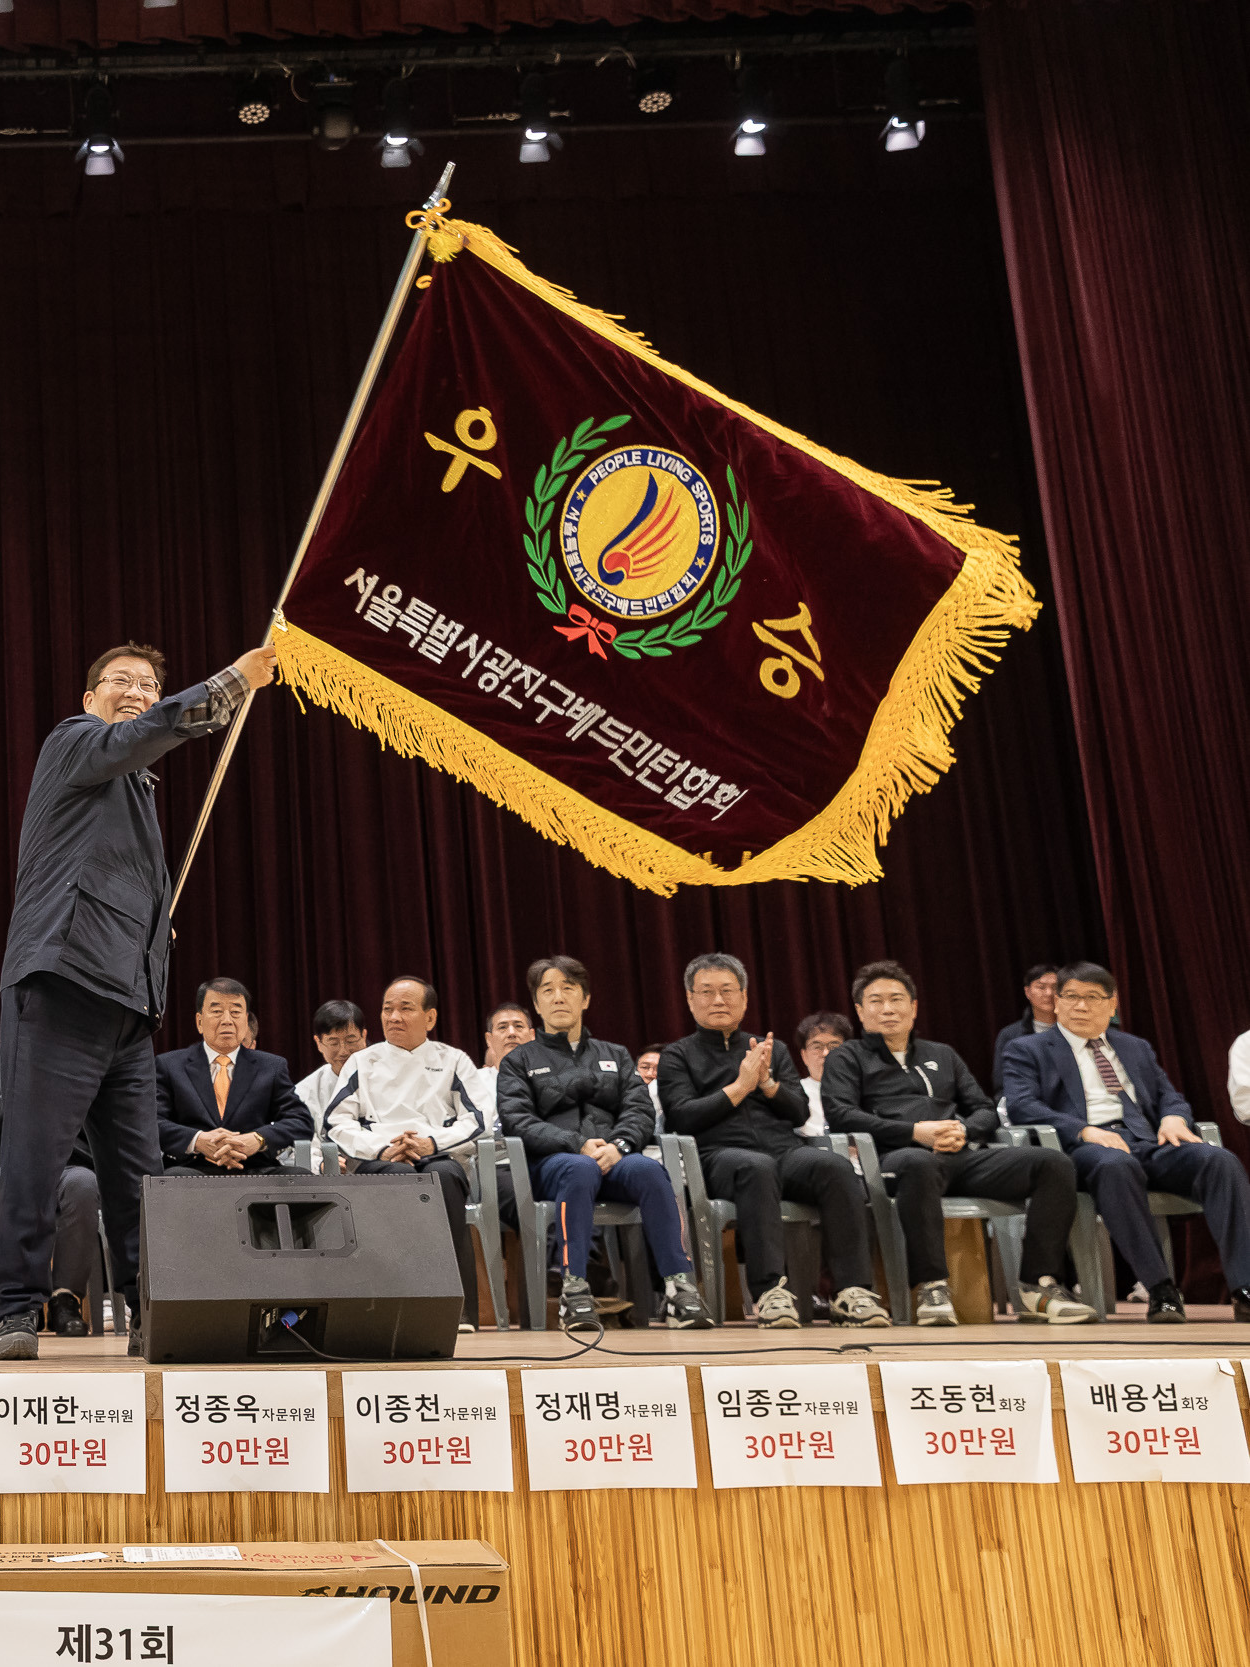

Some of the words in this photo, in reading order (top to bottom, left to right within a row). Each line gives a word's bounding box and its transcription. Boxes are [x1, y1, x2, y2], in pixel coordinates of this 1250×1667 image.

[423, 405, 503, 492] 우
[587, 451, 642, 485] PEOPLE
[646, 451, 692, 483] LIVING
[690, 480, 715, 546] SPORTS
[752, 602, 825, 699] 승
[343, 566, 748, 822] 서울특별시광진구배드민턴협회
[19, 1439, 107, 1467] 30만원
[201, 1436, 289, 1466] 30만원
[383, 1436, 472, 1465] 30만원
[565, 1433, 654, 1463] 30만원
[745, 1430, 835, 1460] 30만원
[925, 1426, 1017, 1456] 30만원
[1107, 1426, 1202, 1456] 30만원
[54, 1624, 176, 1664] 제31회
